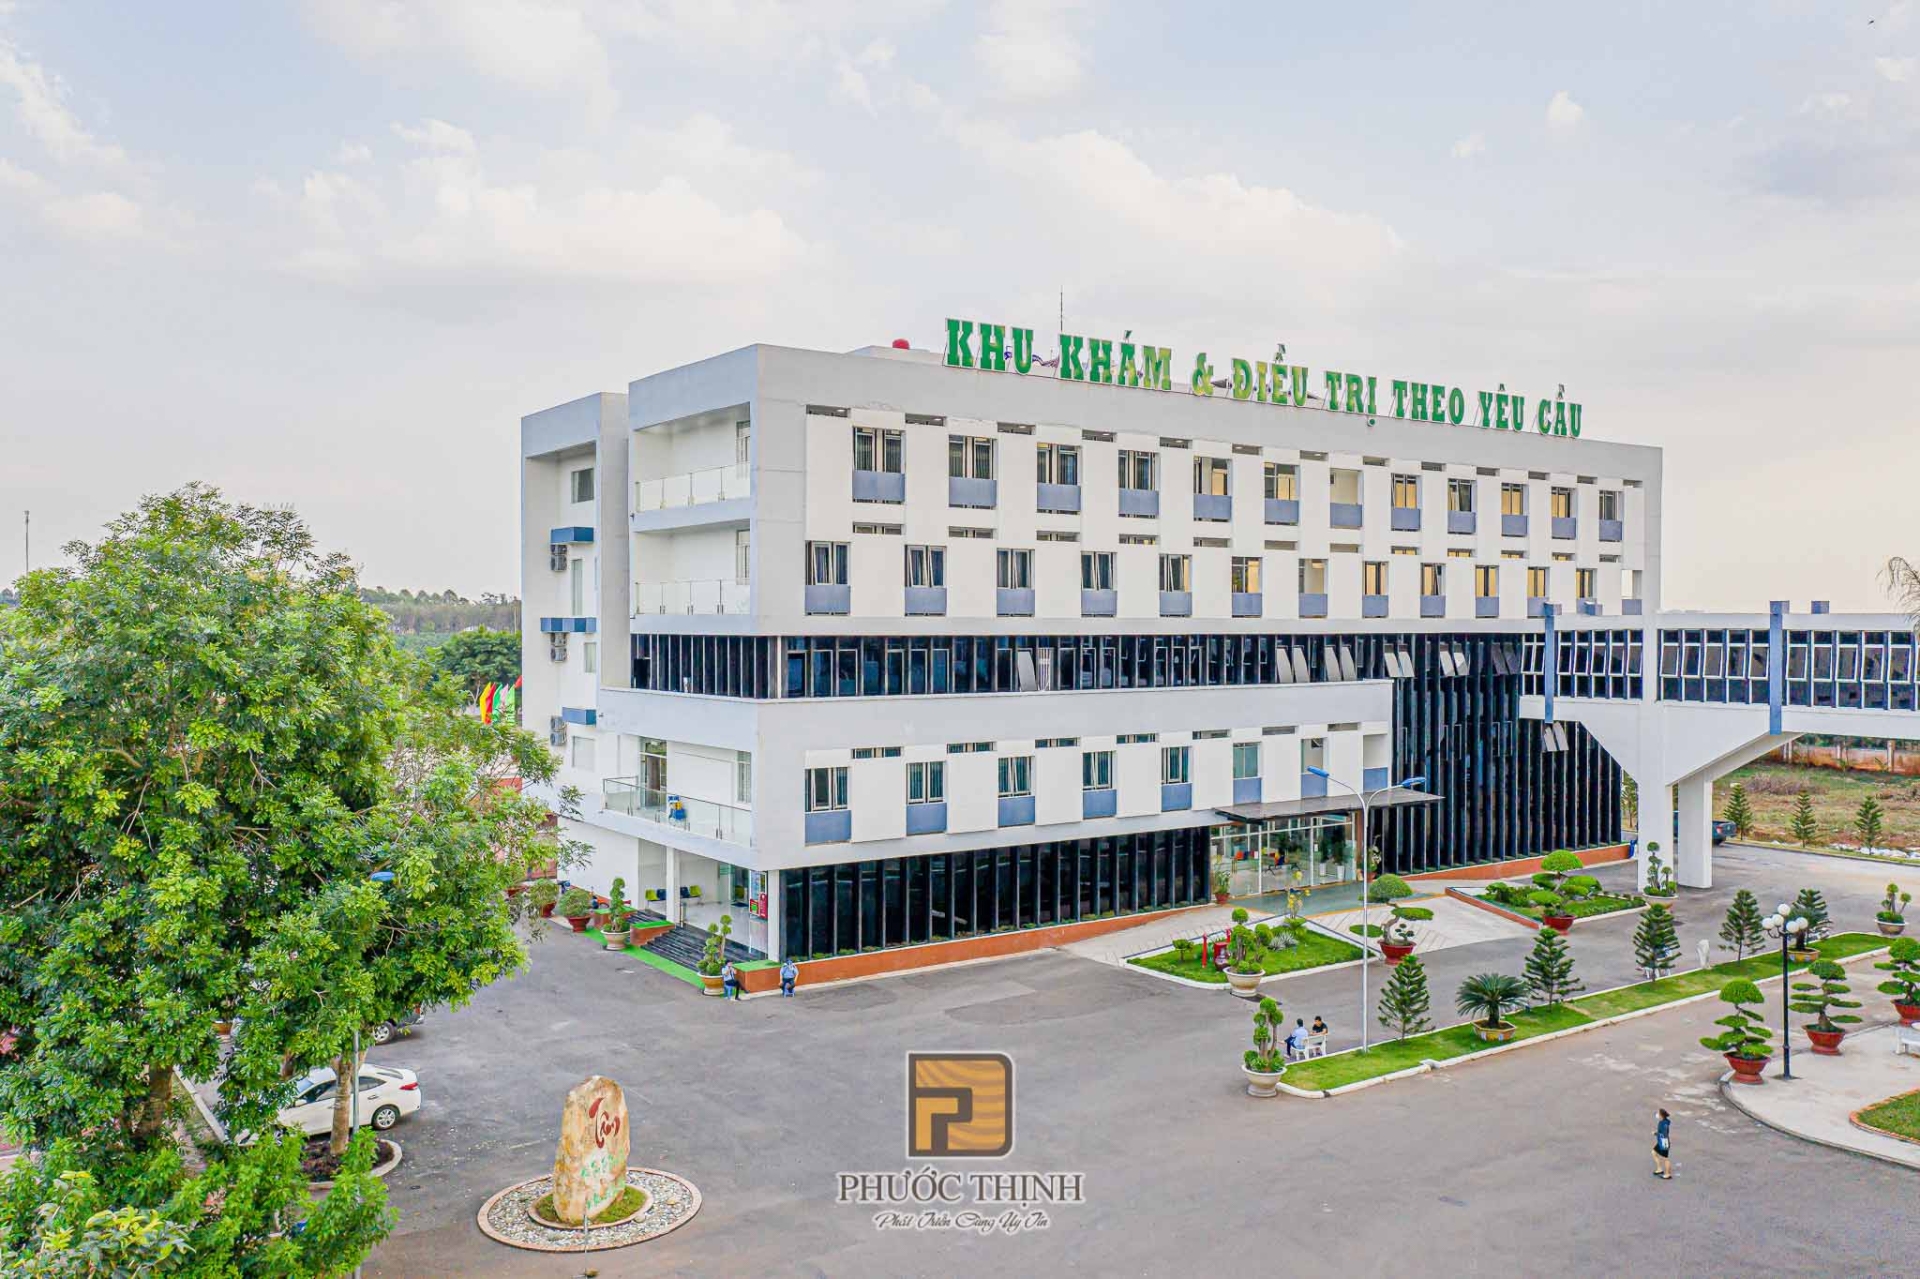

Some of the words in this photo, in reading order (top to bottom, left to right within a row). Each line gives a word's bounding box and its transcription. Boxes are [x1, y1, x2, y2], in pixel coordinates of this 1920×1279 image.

[945, 317, 1034, 375] KHU
[1059, 329, 1173, 392] KHÁM
[1191, 352, 1214, 397] &
[1324, 370, 1378, 427] TRỊ
[1392, 379, 1465, 426] THEO
[1476, 383, 1525, 433] YÊU
[1537, 382, 1583, 438] CẦU
